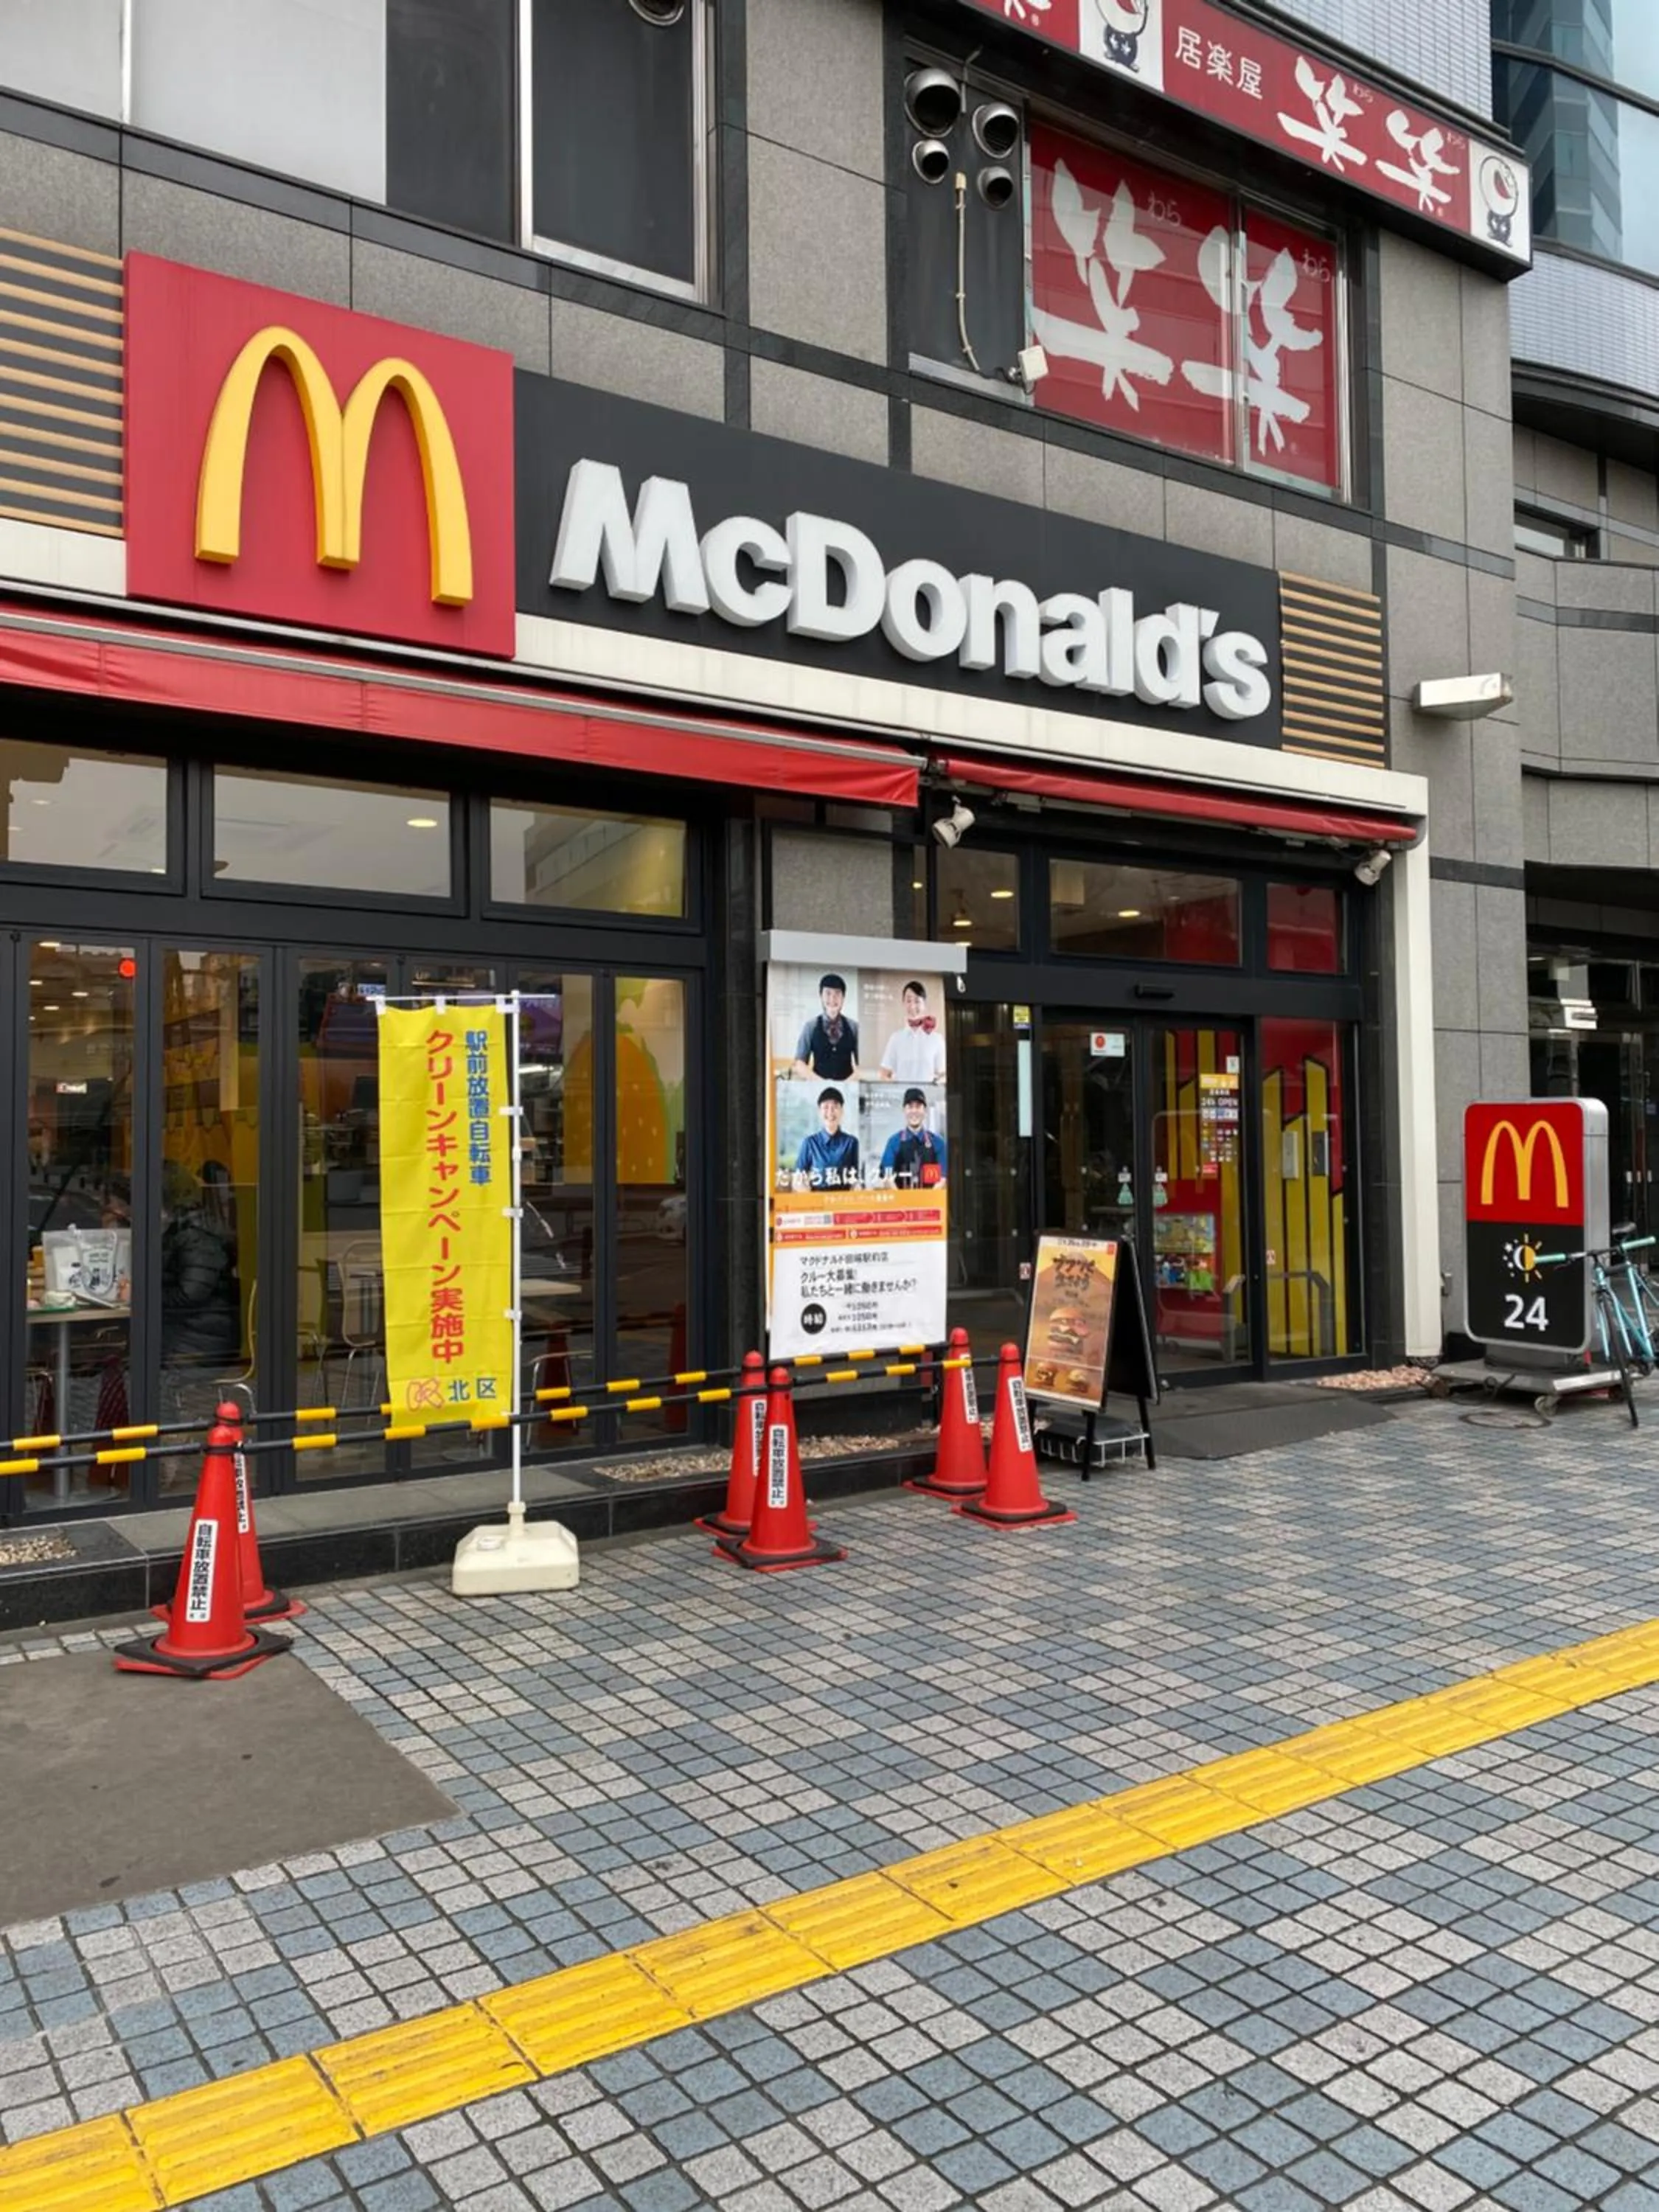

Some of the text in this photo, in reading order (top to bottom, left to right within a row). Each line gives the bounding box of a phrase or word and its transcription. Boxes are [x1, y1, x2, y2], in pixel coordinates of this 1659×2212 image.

[1175, 26, 1263, 100] 居楽屋
[1352, 83, 1374, 103] わら
[1147, 189, 1330, 282] わら わら
[549, 457, 1271, 721] McDonald's
[465, 1029, 492, 1186] 駅前放置自転車
[425, 1029, 465, 1363] クリーンキャンペーン実施中
[1504, 1294, 1548, 1331] 24
[448, 1377, 496, 1402] 北区
